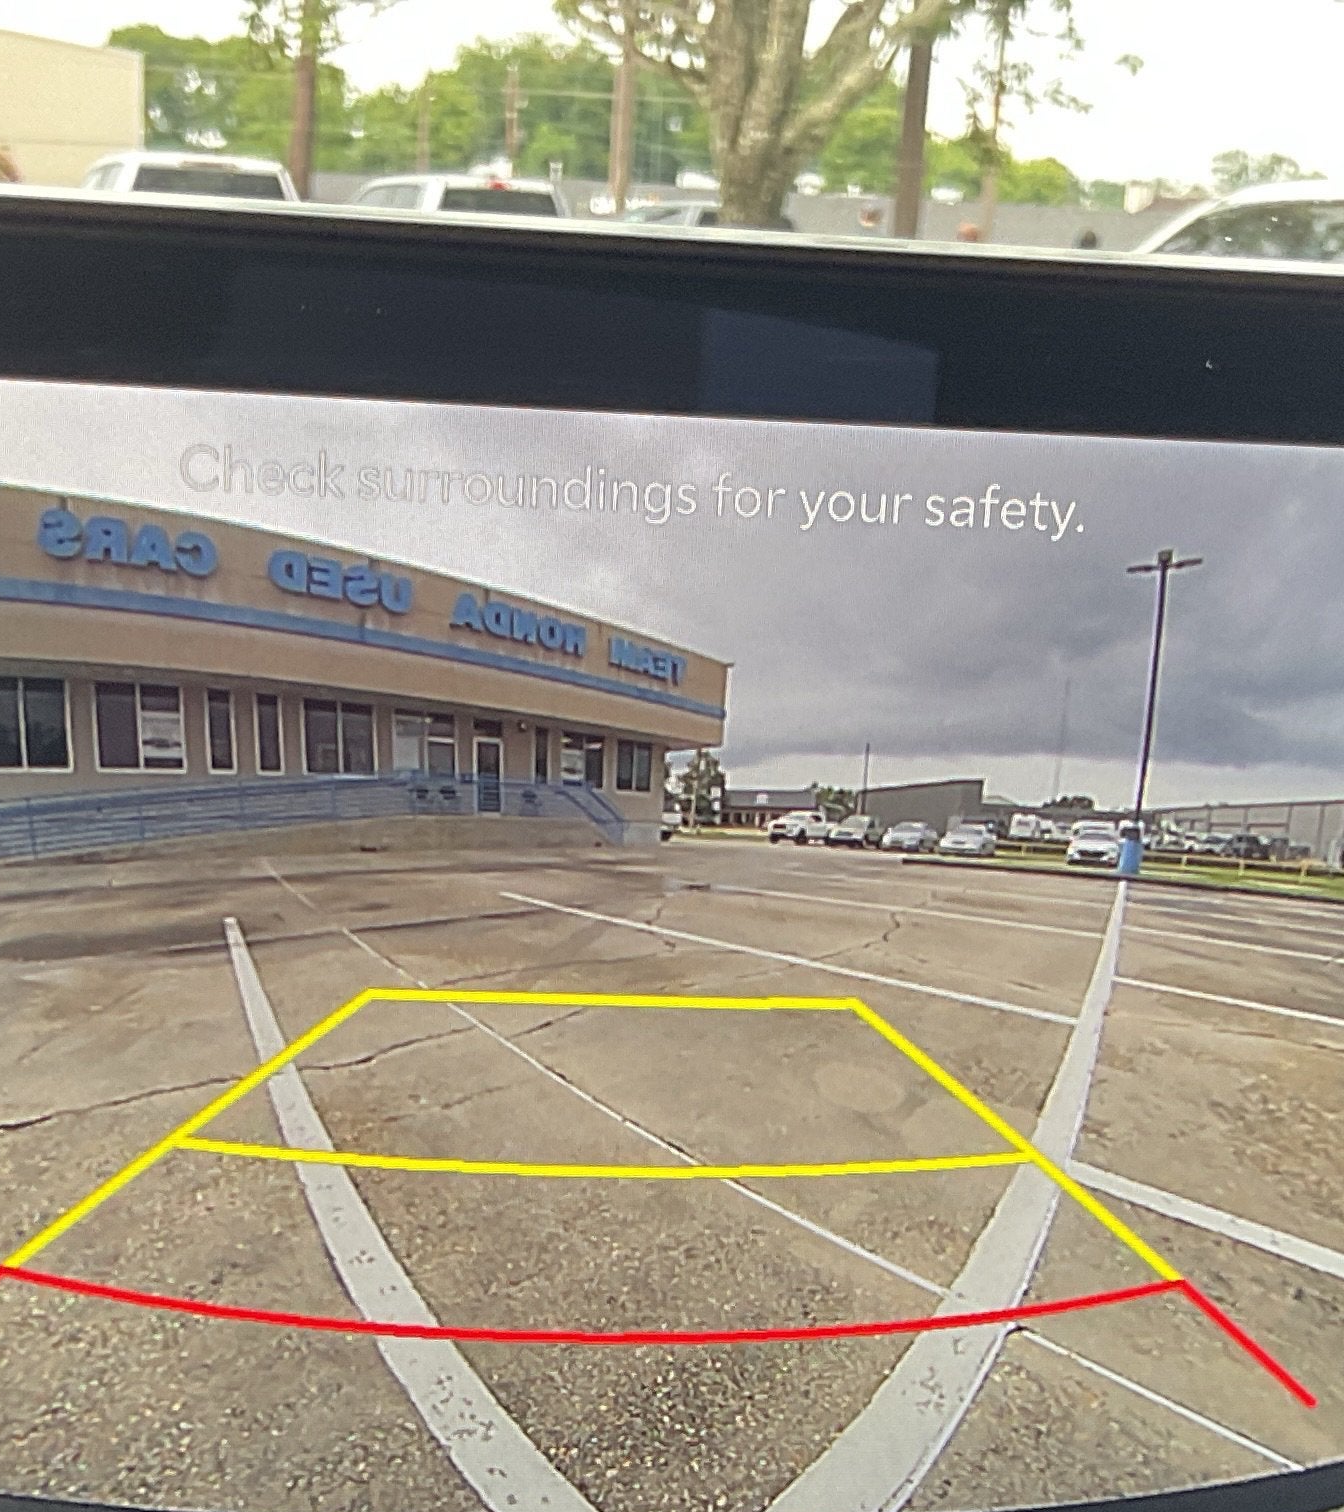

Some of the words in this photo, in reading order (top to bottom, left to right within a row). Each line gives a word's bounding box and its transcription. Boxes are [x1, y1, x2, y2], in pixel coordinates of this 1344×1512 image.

[179, 442, 346, 499] Check
[357, 462, 697, 524] surroundings
[712, 471, 787, 519] for
[800, 489, 913, 530] your
[923, 483, 1086, 541] safety.
